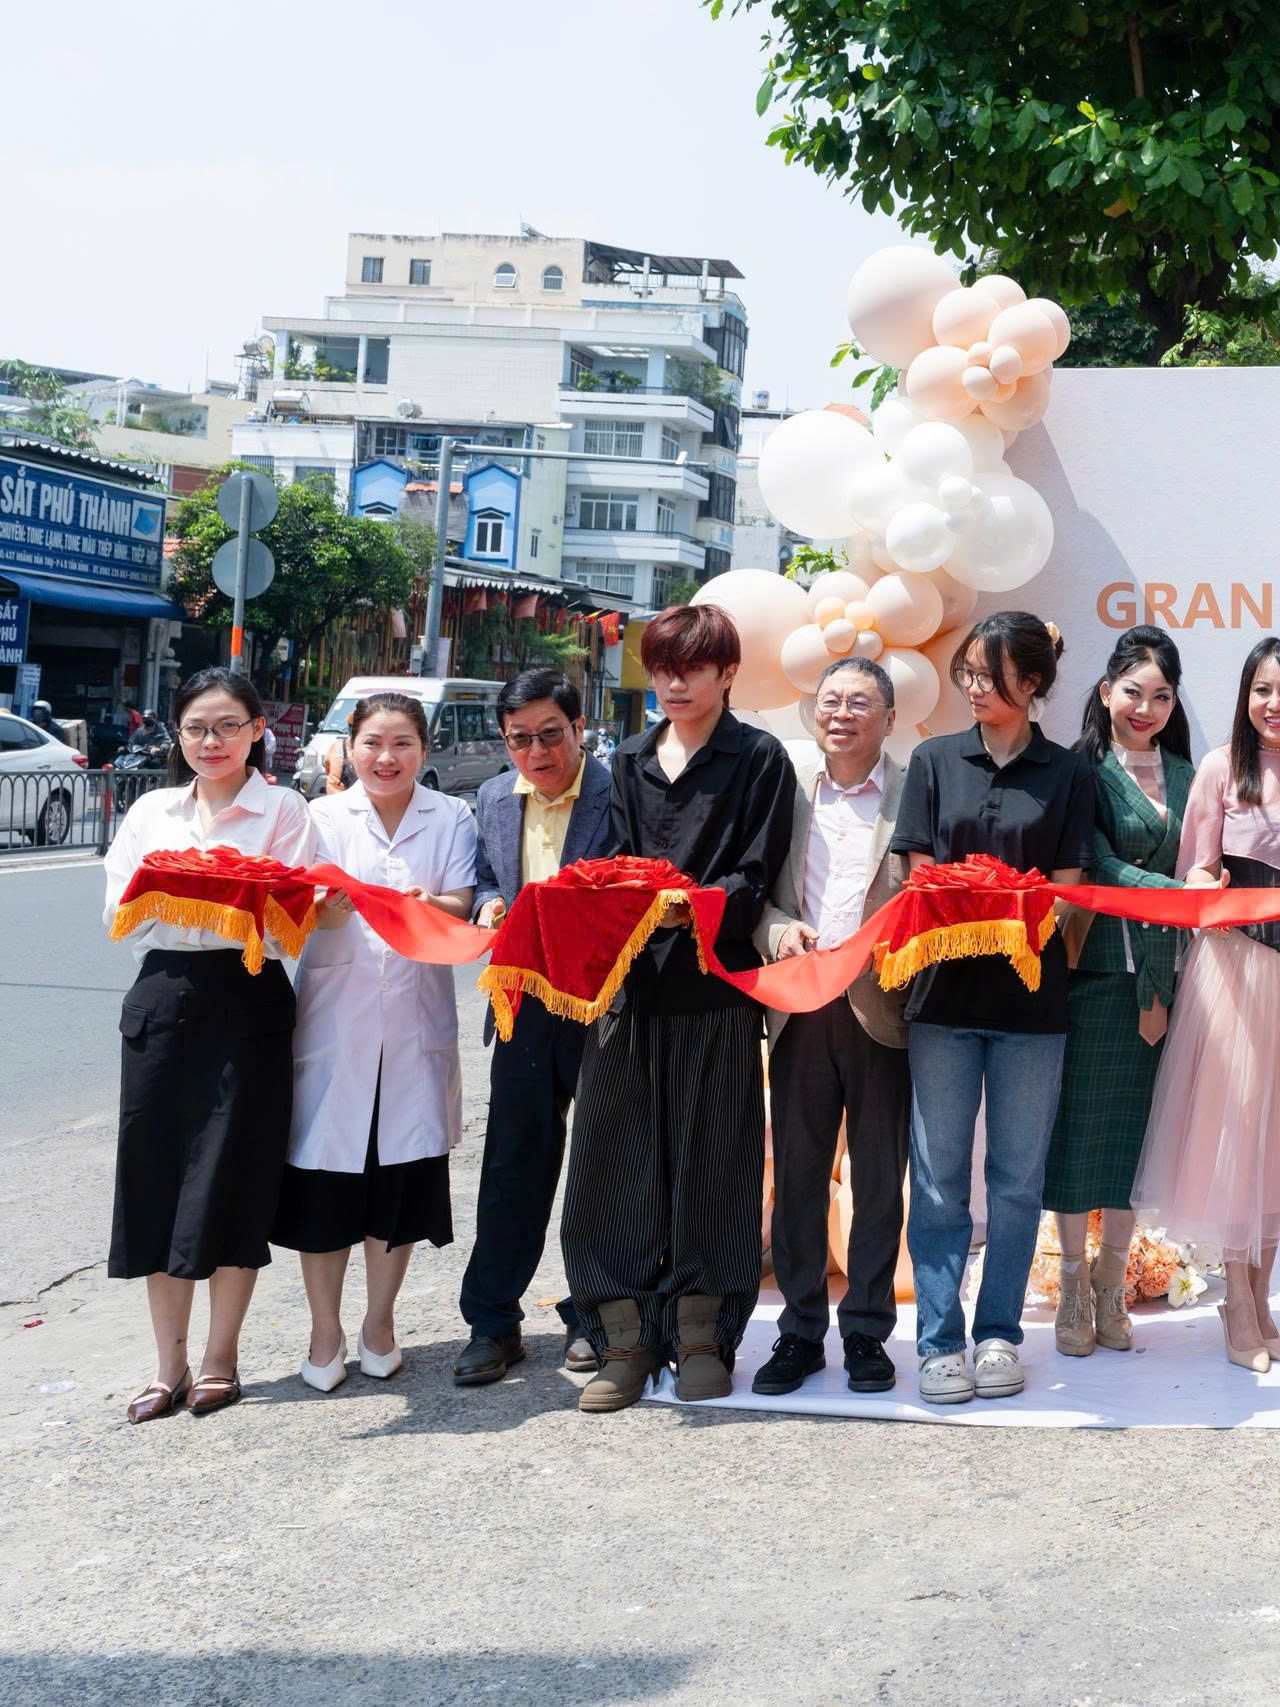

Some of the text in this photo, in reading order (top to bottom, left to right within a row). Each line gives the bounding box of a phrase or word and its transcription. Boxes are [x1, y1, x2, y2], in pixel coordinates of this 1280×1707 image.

[1, 466, 132, 538] SẮT PHÚ THÀNH
[0, 624, 17, 642] HÚ
